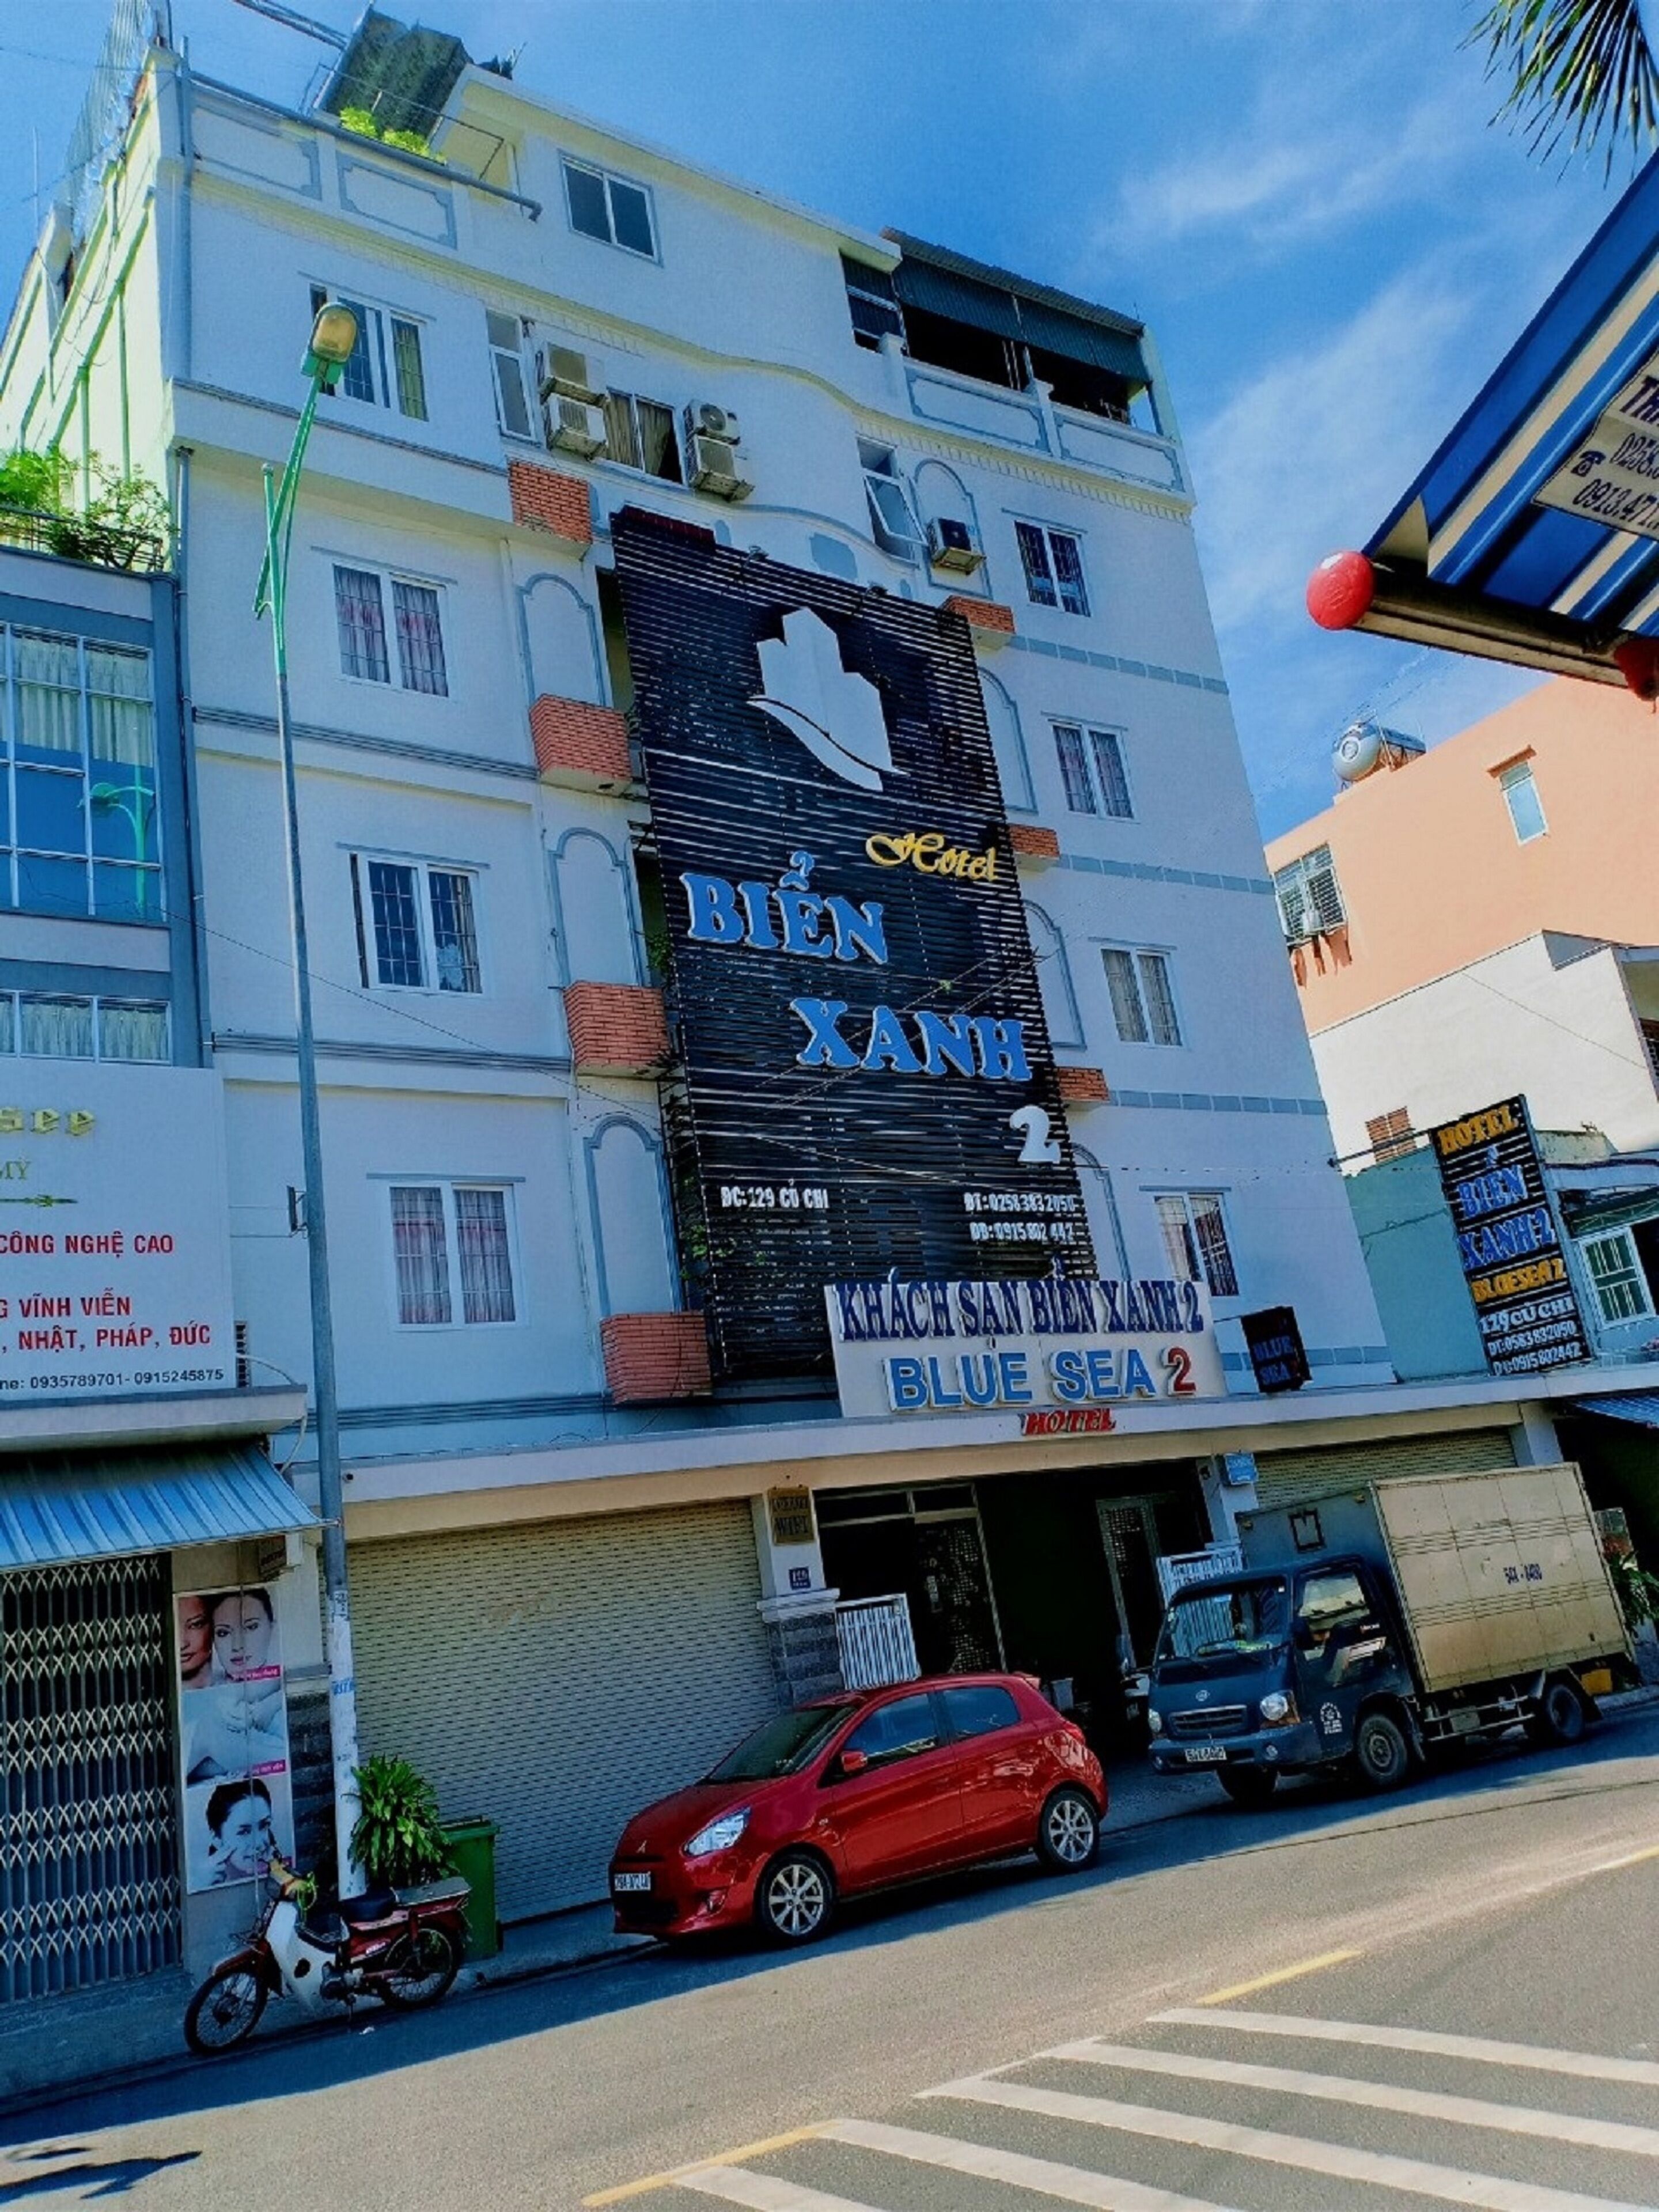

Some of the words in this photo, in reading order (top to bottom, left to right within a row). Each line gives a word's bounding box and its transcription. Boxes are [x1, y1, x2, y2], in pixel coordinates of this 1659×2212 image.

[866, 833, 998, 882] Hotel
[680, 851, 888, 964] BIỂN
[790, 998, 1032, 1081] XANH
[1009, 1106, 1061, 1162] 2
[1438, 1104, 1518, 1155] HOTEL
[802, 1188, 830, 1209] CHI
[0, 1230, 54, 1255] CÔNG
[65, 1230, 124, 1258] NGHỆ
[134, 1234, 174, 1254] CAO
[19, 1293, 70, 1318] VĨNH
[80, 1287, 131, 1316] VIỄN
[834, 1267, 956, 1342] KHÁCH
[956, 1280, 1024, 1349] SẠN
[1096, 1279, 1183, 1333] XANH
[19, 1325, 85, 1353] NHẬT,
[97, 1322, 160, 1348] PHÁP,
[169, 1320, 210, 1346] ĐỨC
[1253, 1335, 1294, 1361] BLUE
[134, 1369, 224, 1385] 0915245875
[884, 1351, 1032, 1411] BLUE
[1051, 1348, 1156, 1402] SEA
[1161, 1346, 1196, 1396] 2
[1018, 1408, 1116, 1435] HOTEL
